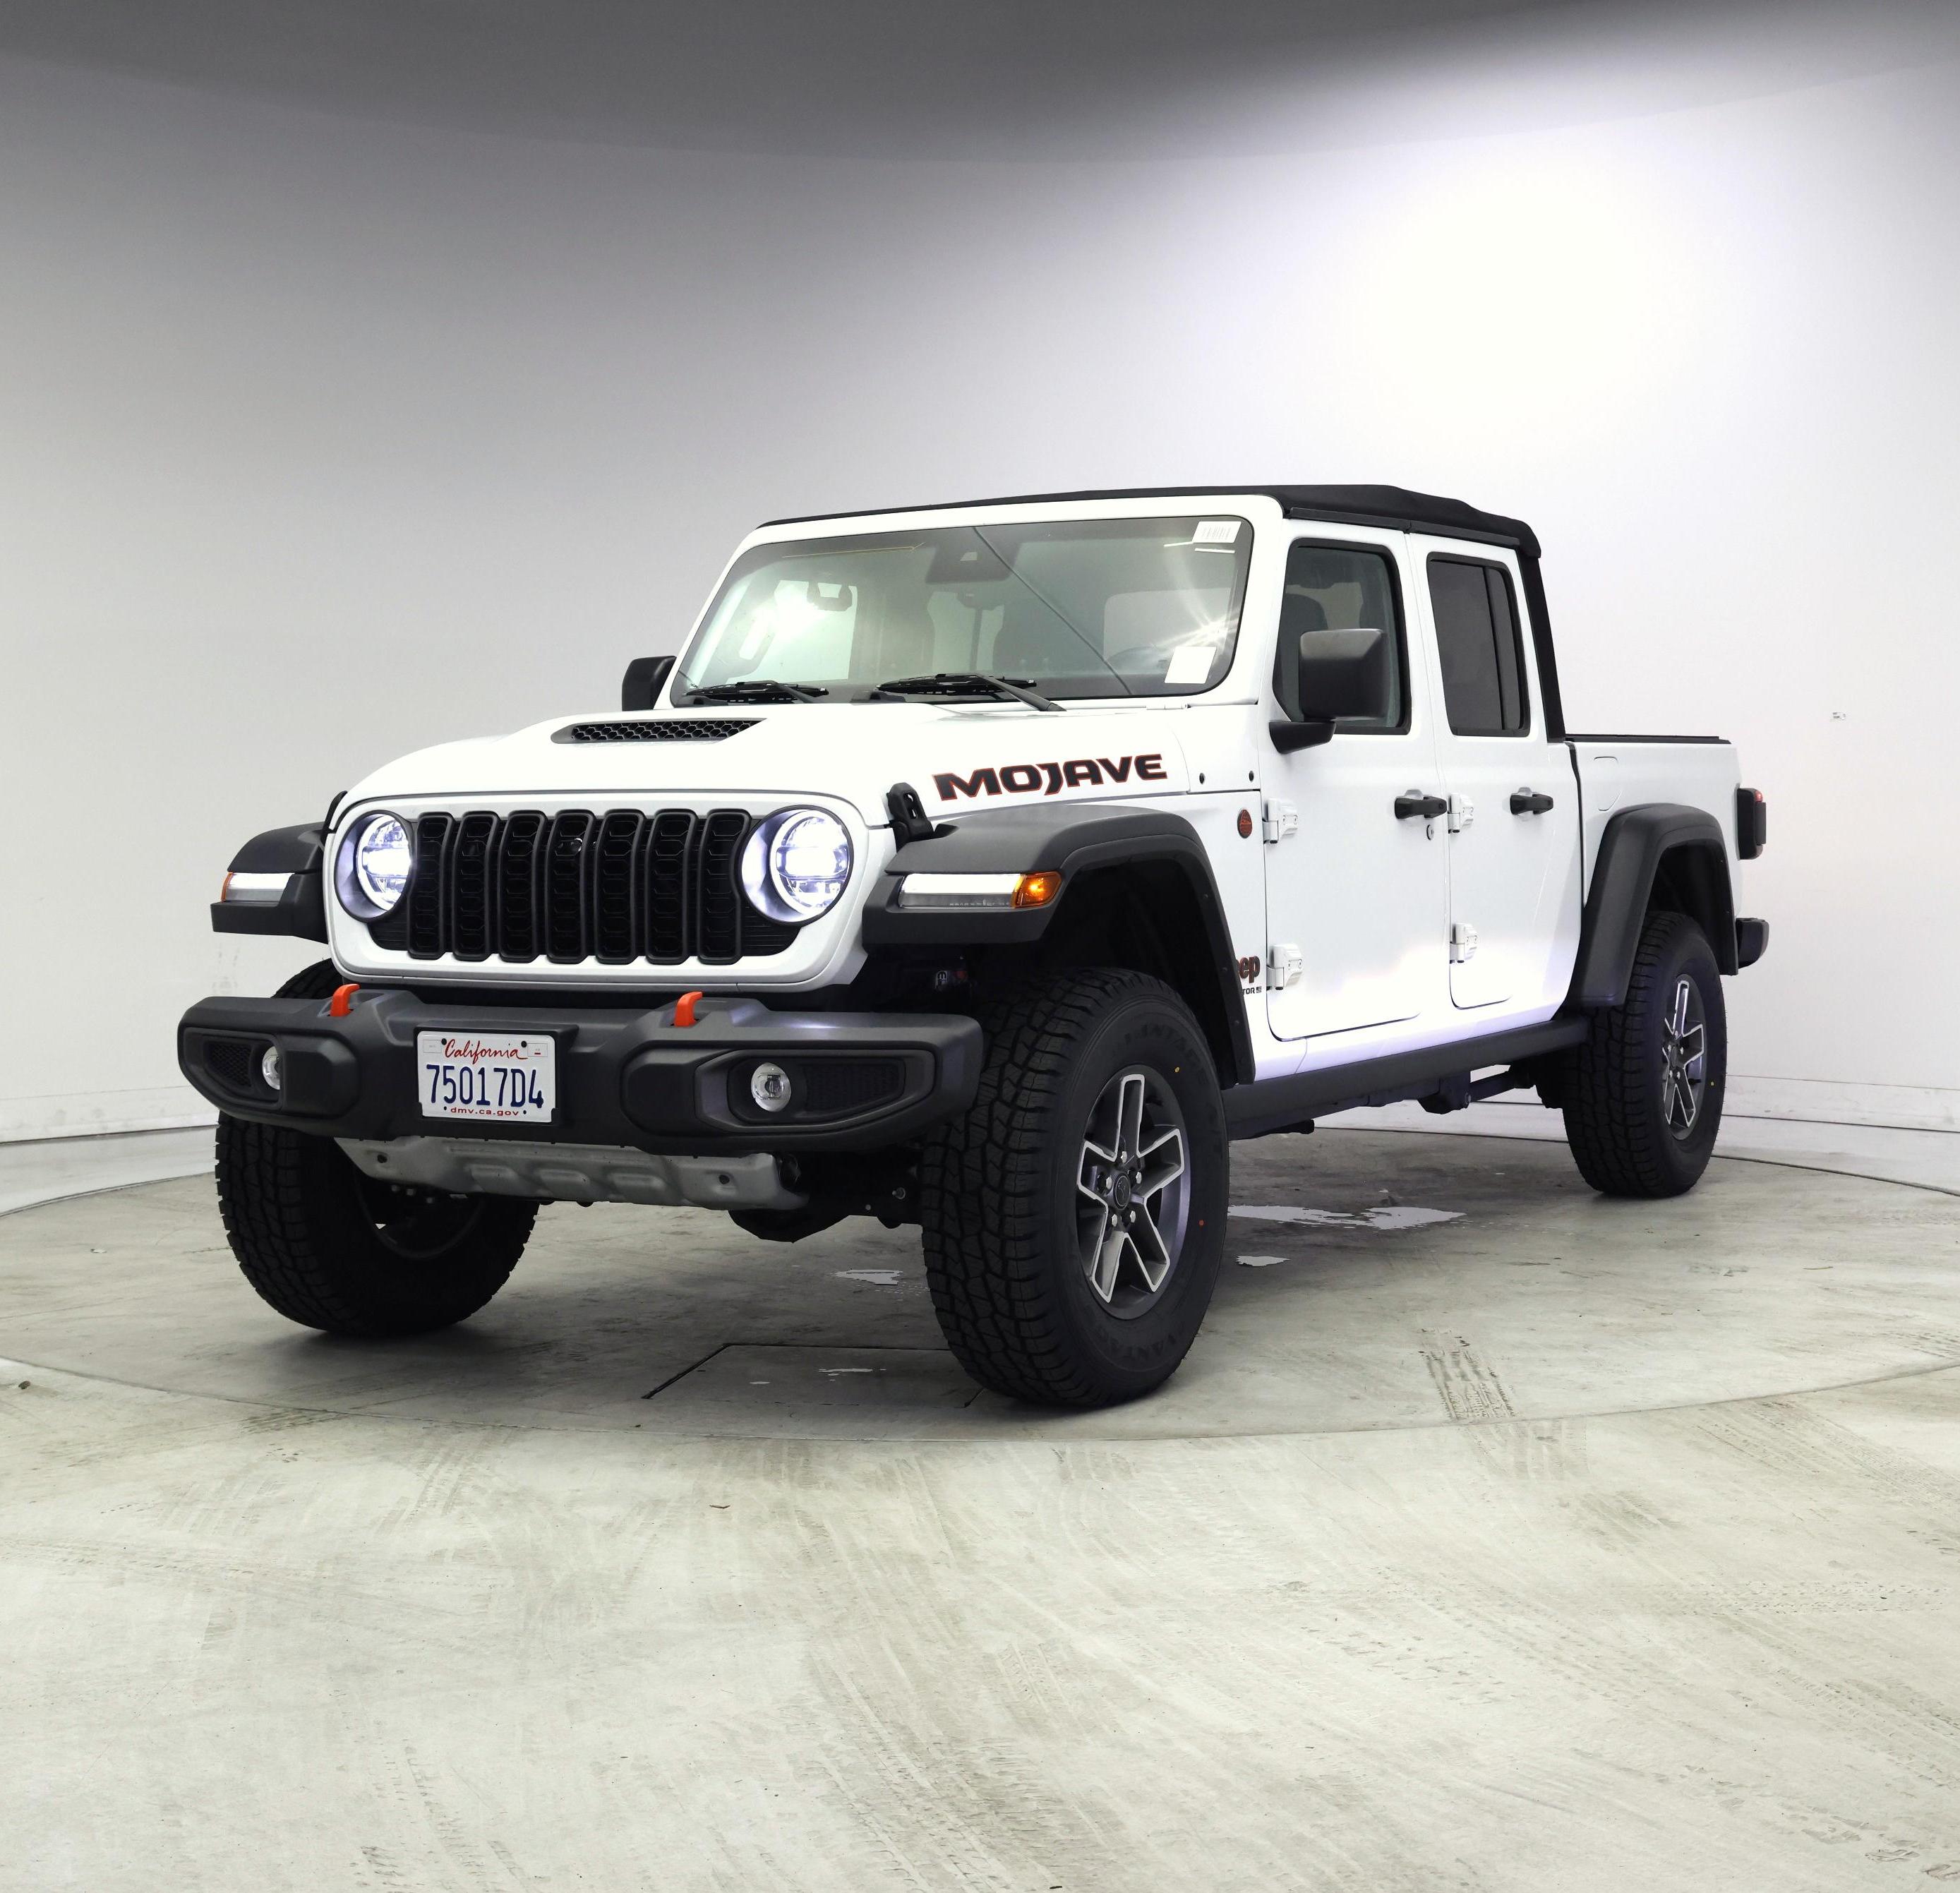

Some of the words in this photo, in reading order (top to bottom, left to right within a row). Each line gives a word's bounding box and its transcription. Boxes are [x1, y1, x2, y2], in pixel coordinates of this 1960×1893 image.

[931, 753, 1168, 801] MOJAVE
[1237, 956, 1260, 983] ep
[444, 1038, 528, 1064] California
[426, 1064, 544, 1109] 75017D4
[450, 1107, 519, 1116] dmv.ca.gov
